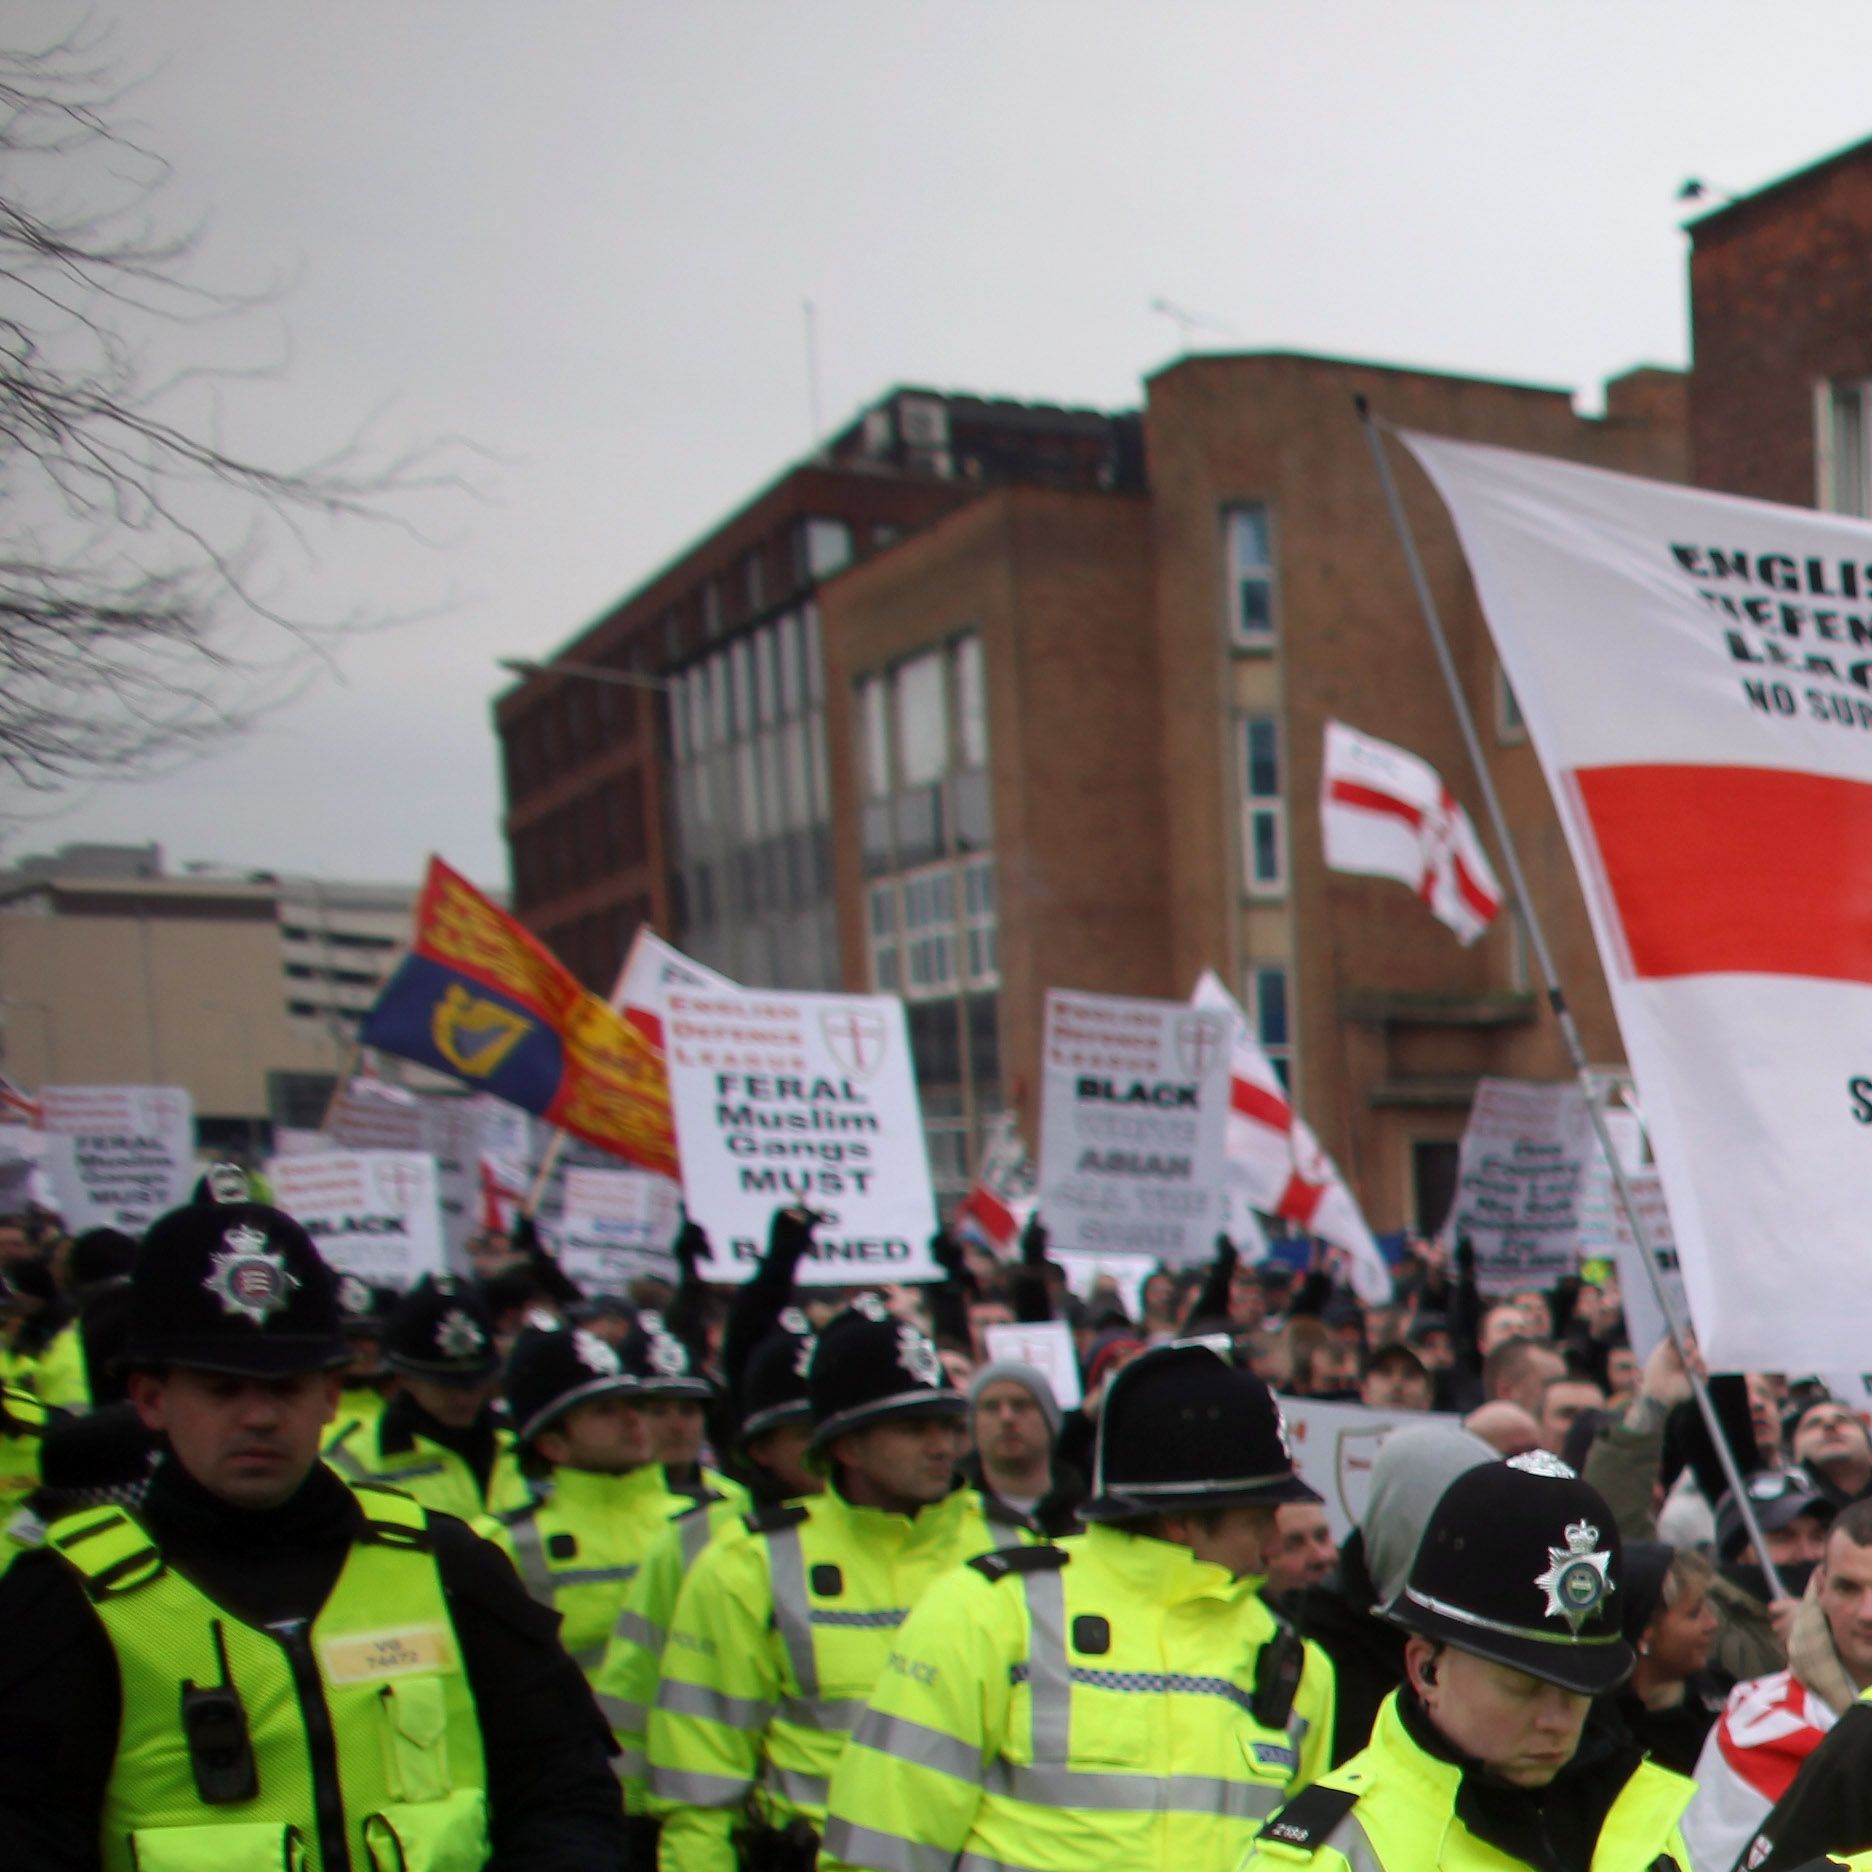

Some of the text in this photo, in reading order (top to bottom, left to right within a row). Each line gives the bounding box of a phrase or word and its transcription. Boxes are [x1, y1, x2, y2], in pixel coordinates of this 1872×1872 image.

[1741, 678, 1796, 717] NO
[715, 1073, 868, 1102] FERAL
[1075, 1076, 1198, 1111] BLACK
[715, 1103, 879, 1132] Muslim
[726, 1134, 871, 1163] Gangs
[740, 1169, 874, 1194] MUST
